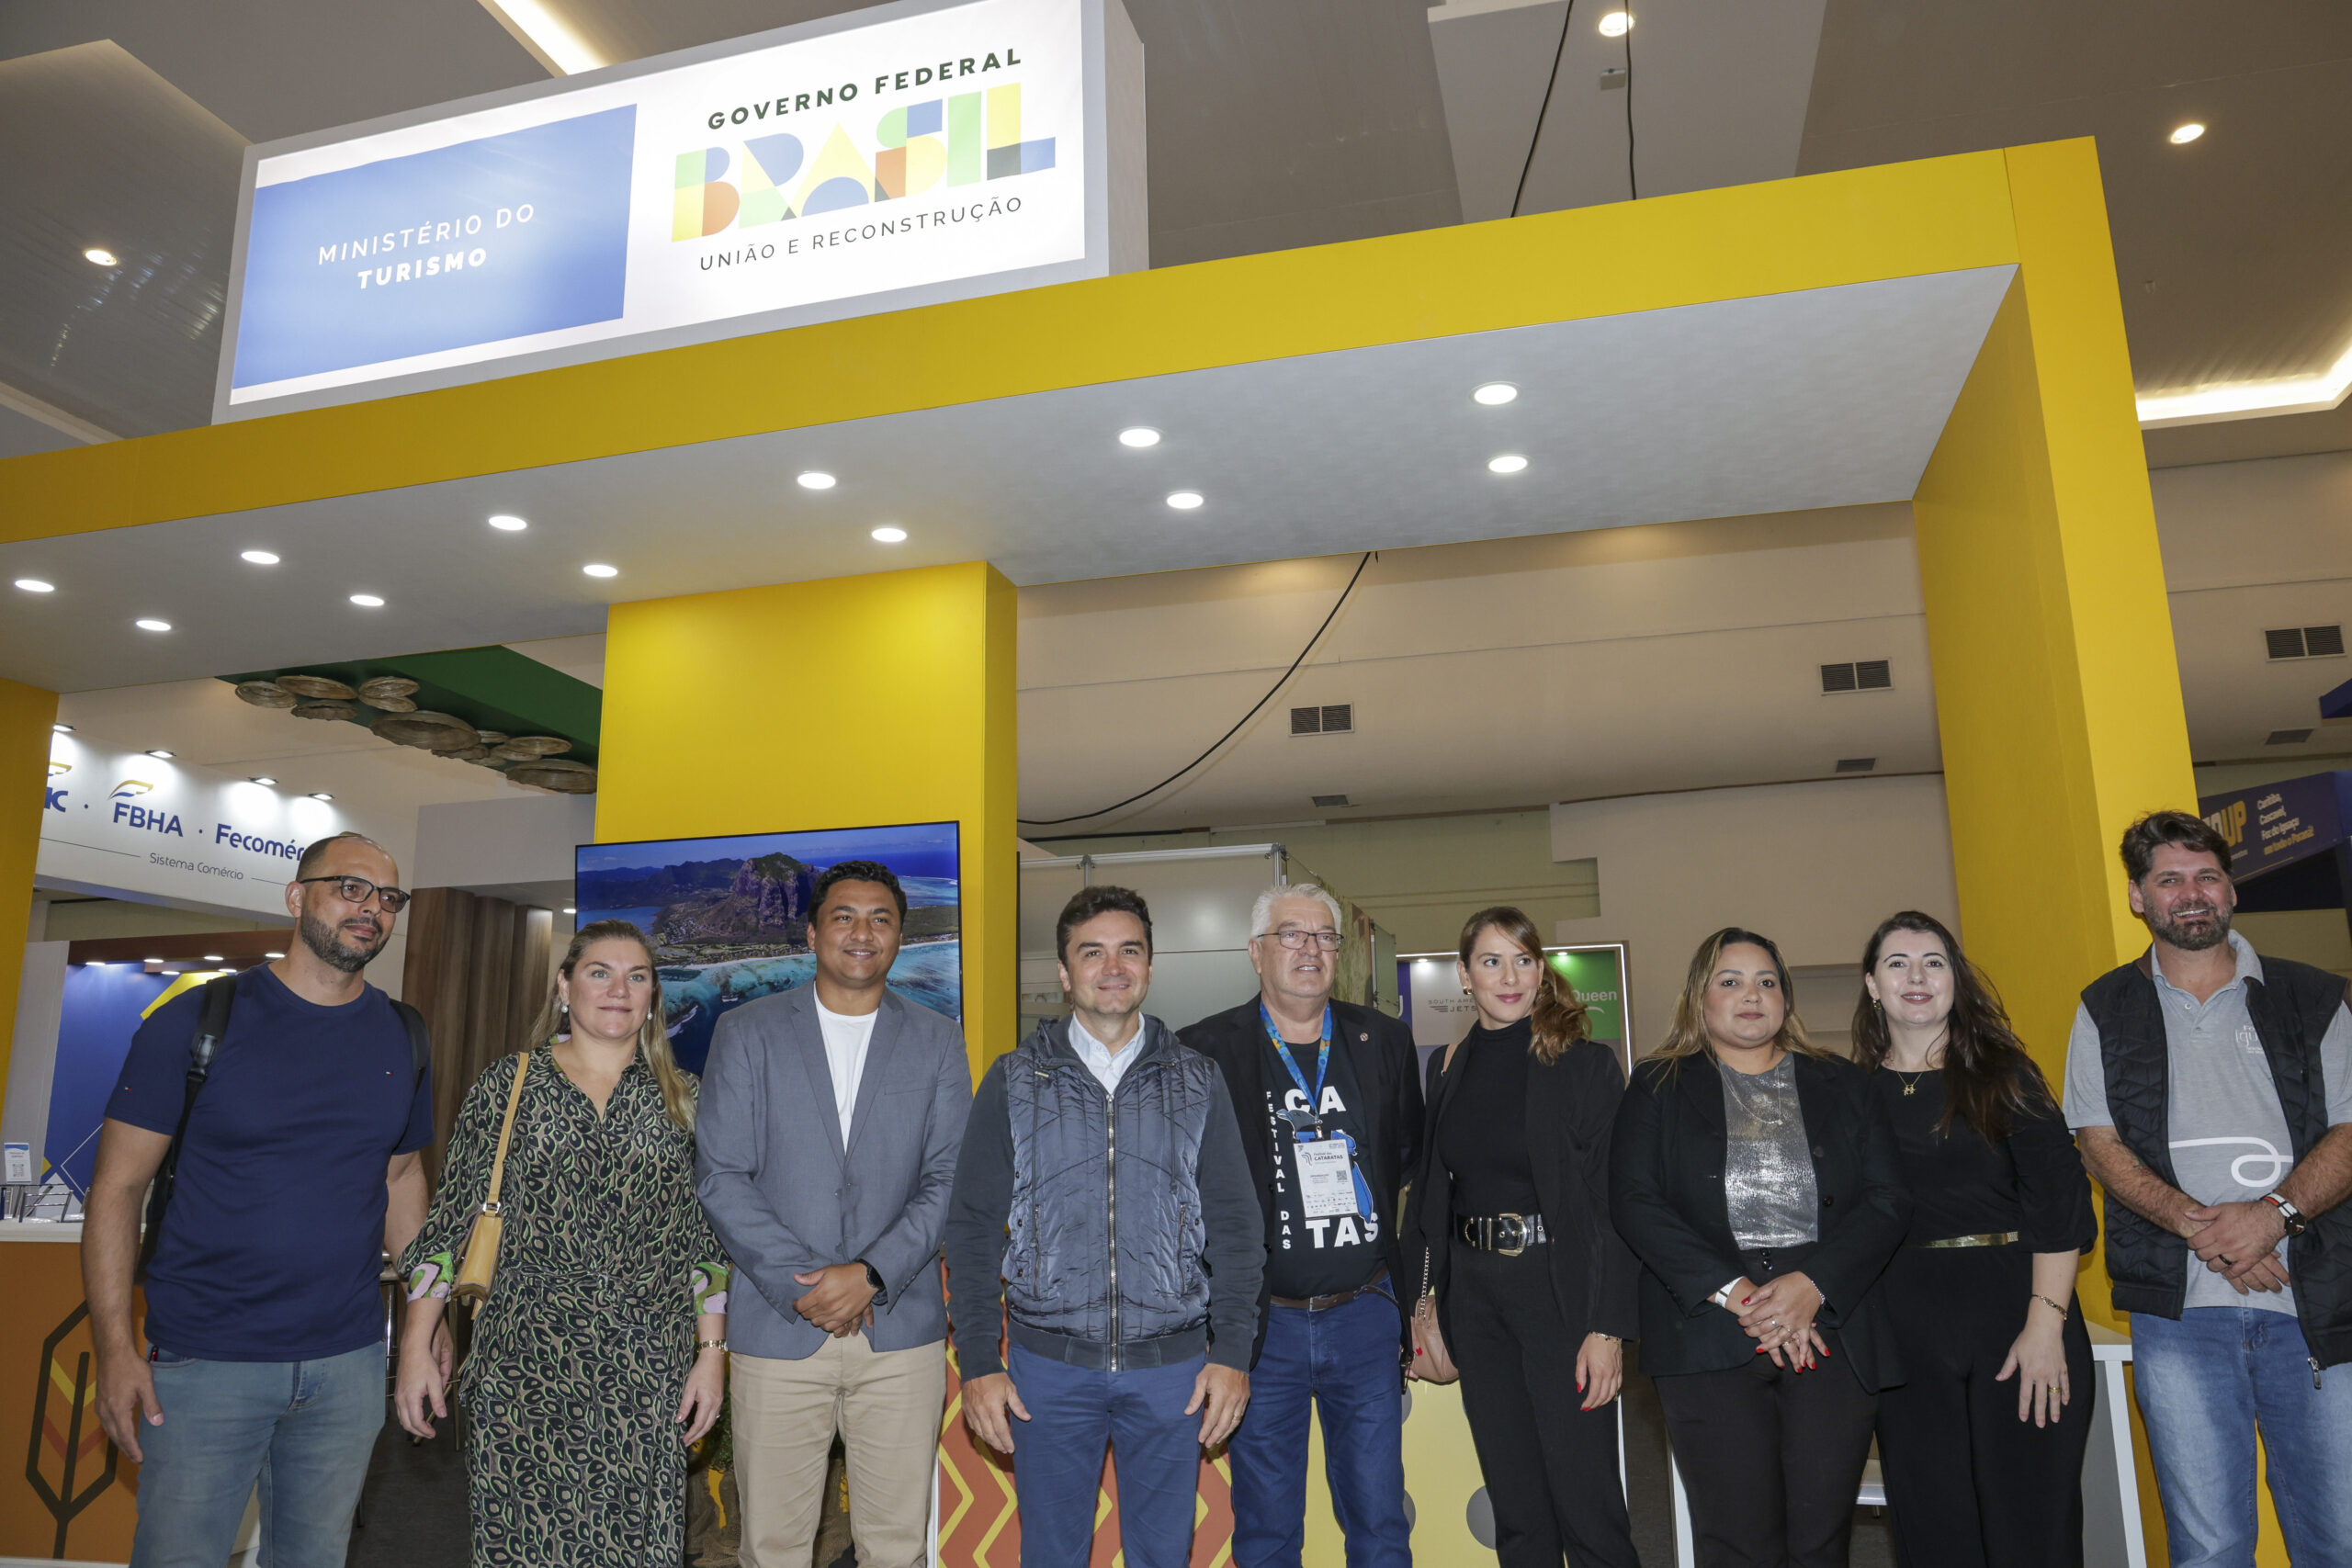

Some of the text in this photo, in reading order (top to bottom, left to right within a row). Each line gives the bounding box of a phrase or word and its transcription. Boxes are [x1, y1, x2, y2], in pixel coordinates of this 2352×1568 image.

[708, 48, 1022, 130] GOVERNO FEDERAL
[672, 82, 1057, 243] BRASIL
[318, 203, 535, 265] MINISTÉRIO DO
[699, 196, 1023, 271] UNIÃO E RECONSTRUÇÃO
[356, 247, 487, 289] TURISMO
[113, 802, 184, 838] FBHA
[215, 823, 304, 862] Fecomér
[149, 852, 244, 881] Sistema Comércio
[1572, 988, 1617, 1002] Queen
[2234, 1029, 2258, 1047] Igu
[1266, 1090, 1292, 1249] FESTIVAL DAS
